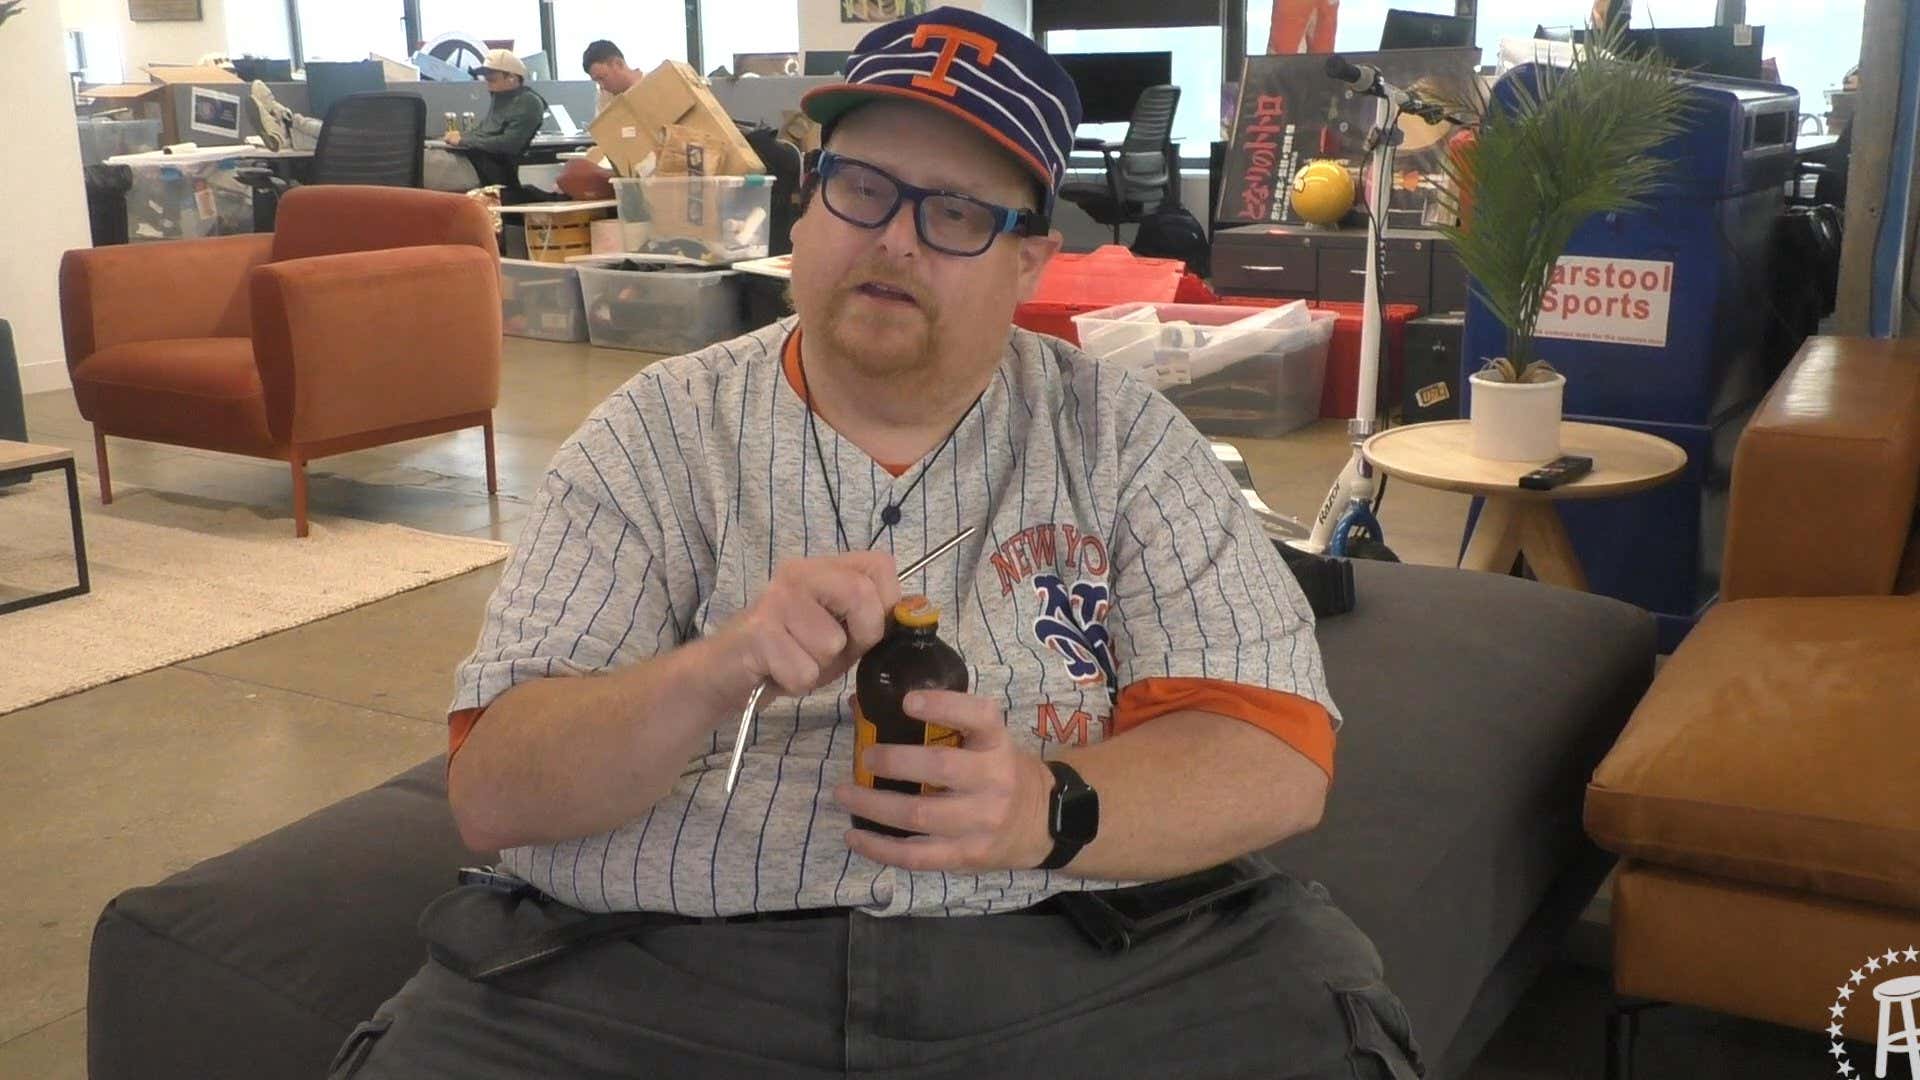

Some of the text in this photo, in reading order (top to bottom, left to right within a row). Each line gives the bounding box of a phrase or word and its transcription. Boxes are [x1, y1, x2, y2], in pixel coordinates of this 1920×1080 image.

[911, 23, 998, 97] T
[1540, 286, 1650, 320] Sports
[1550, 263, 1671, 292] arstool
[989, 523, 1109, 598] NEW YO
